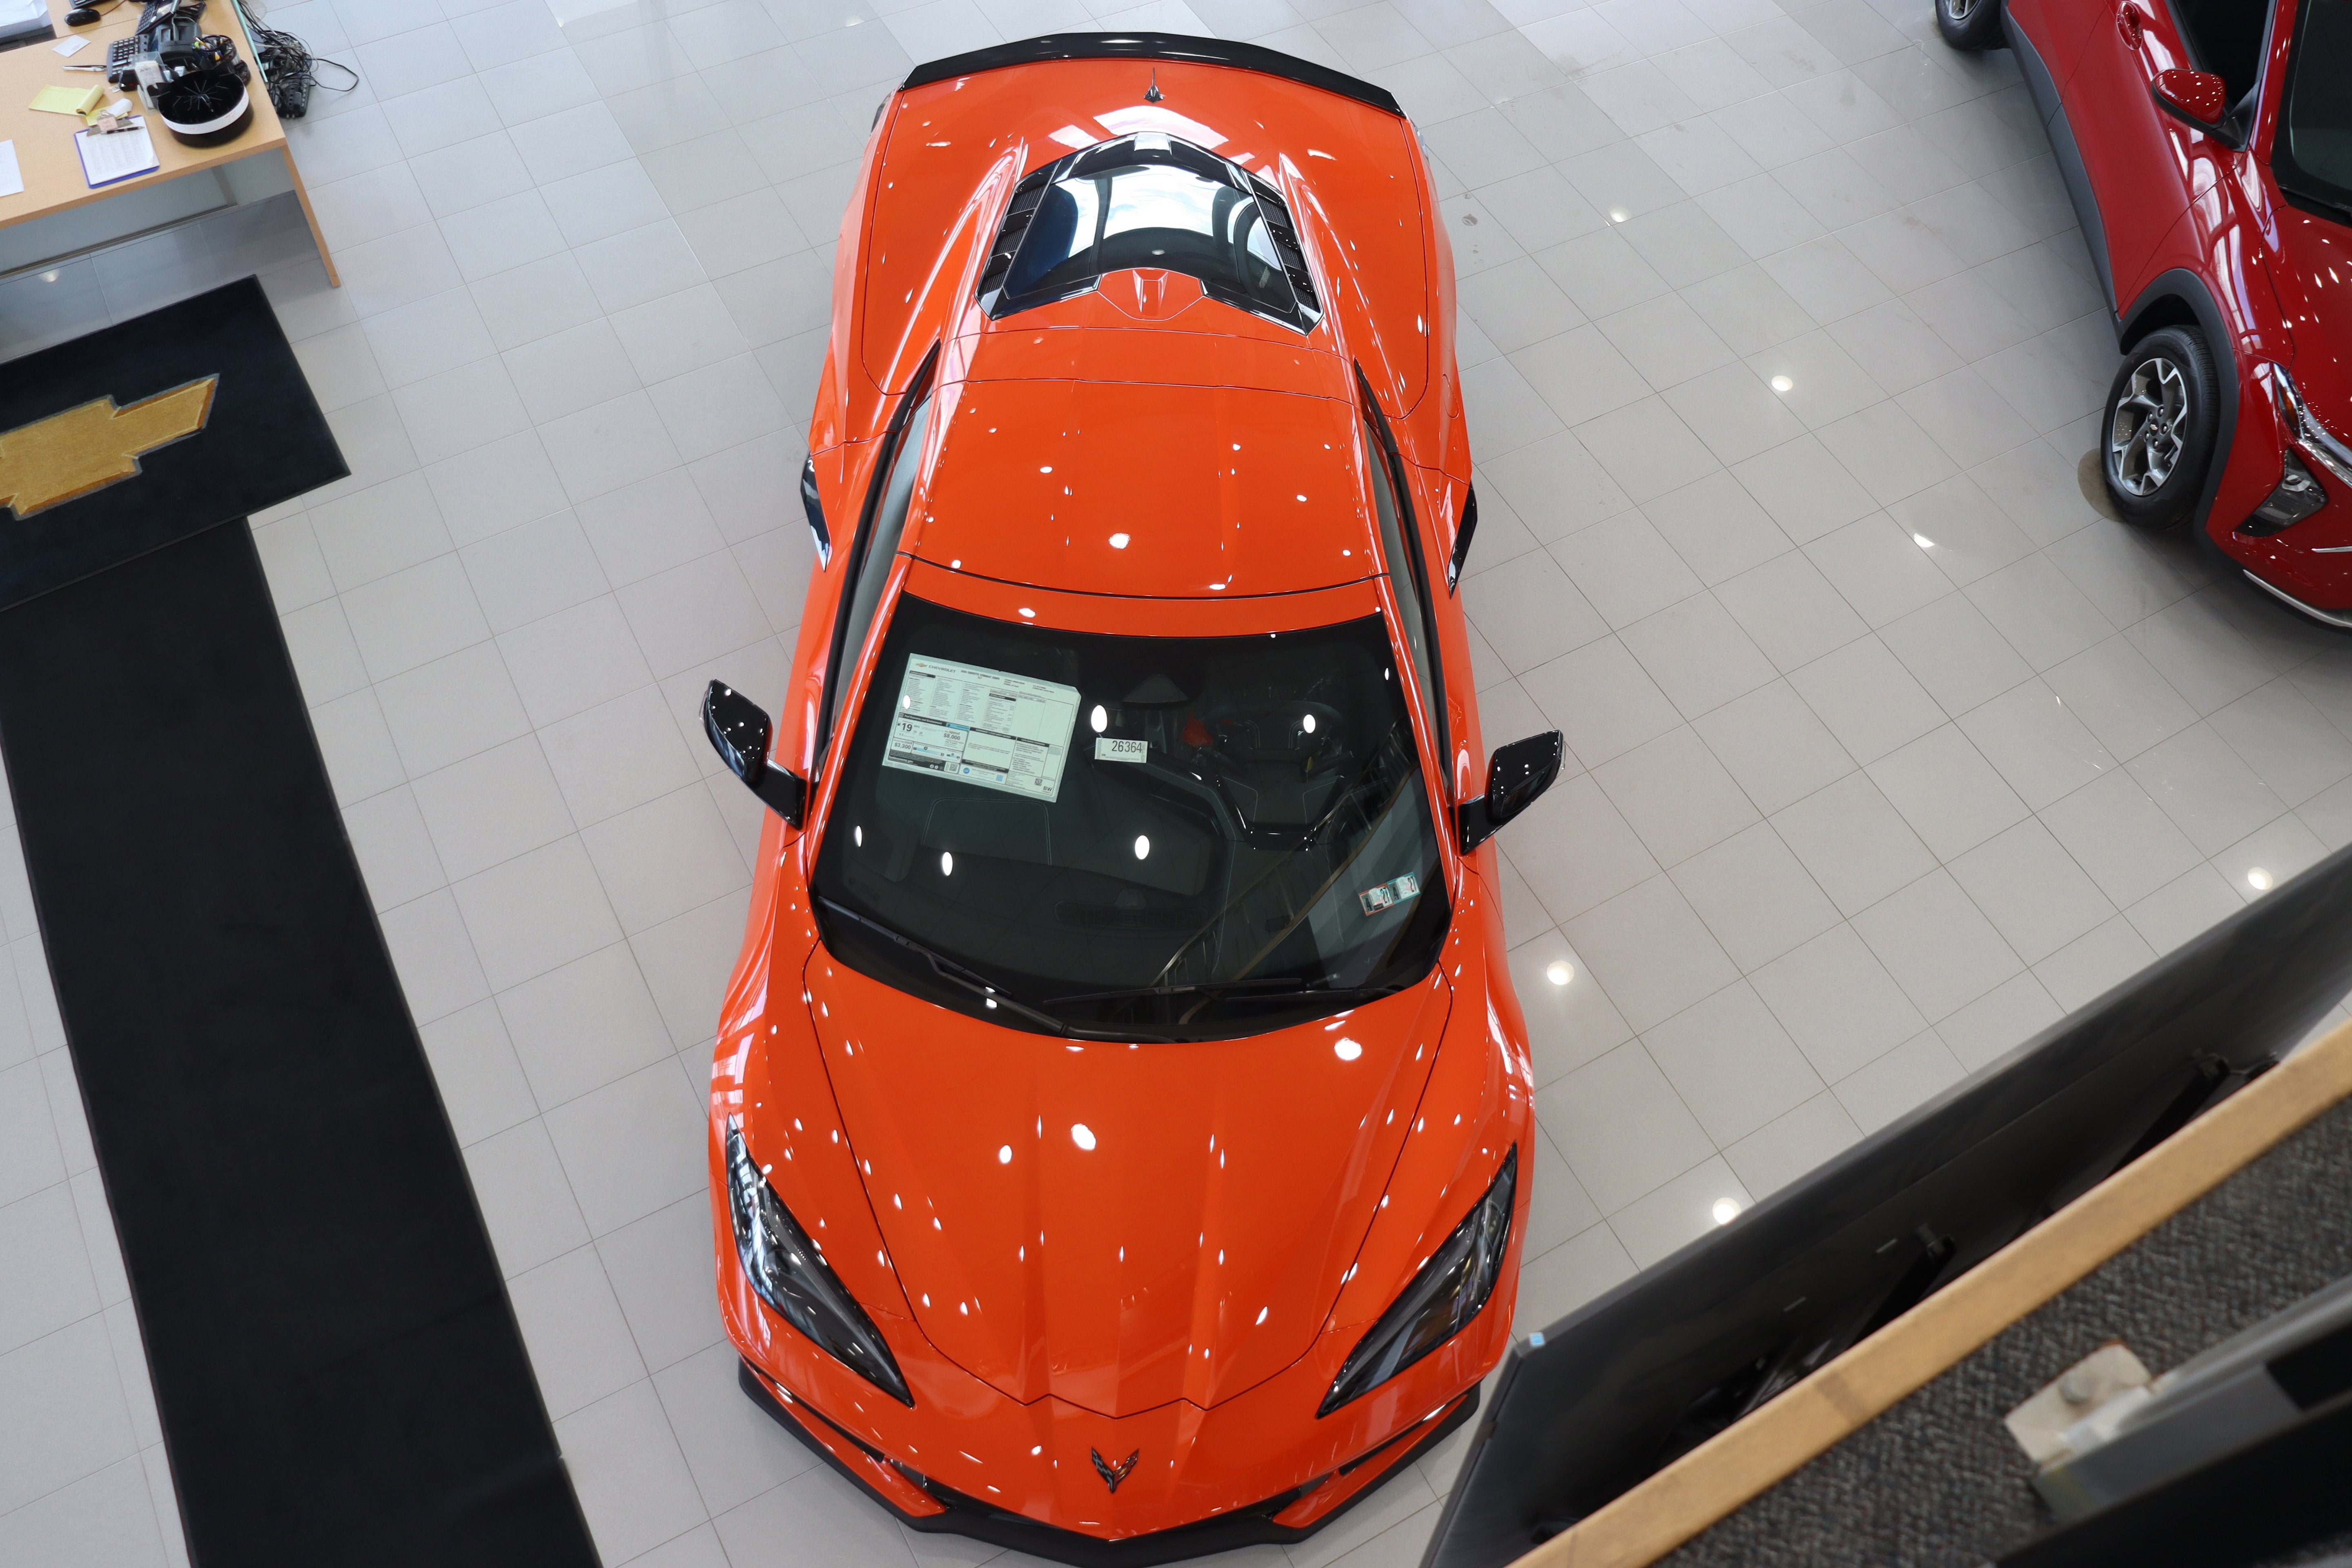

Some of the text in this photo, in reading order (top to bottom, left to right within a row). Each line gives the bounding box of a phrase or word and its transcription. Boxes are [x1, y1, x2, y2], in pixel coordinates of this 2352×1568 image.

[929, 665, 956, 673] CHEVROLET
[902, 723, 913, 732] 19
[1112, 740, 1142, 753] 26364
